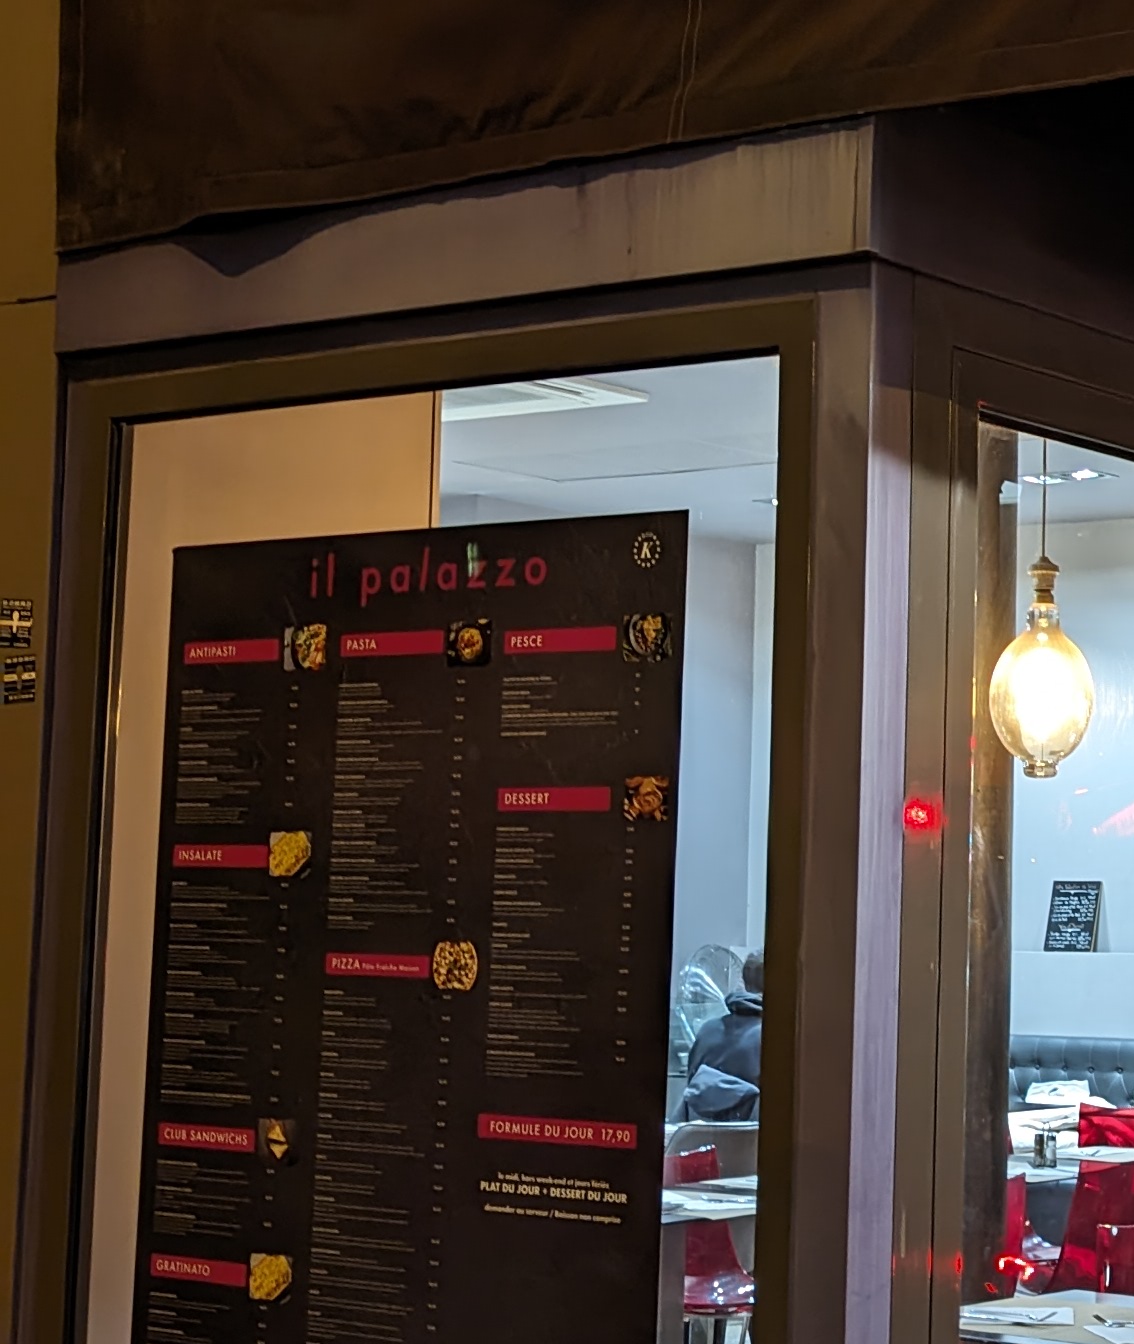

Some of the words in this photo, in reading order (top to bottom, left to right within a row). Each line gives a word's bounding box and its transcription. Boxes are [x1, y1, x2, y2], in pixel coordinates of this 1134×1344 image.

[310, 552, 336, 599] il
[360, 545, 548, 608] palazzo
[346, 638, 377, 651] PASTA
[510, 634, 543, 648] PESCE
[189, 646, 236, 659] ANTIPASTI
[504, 792, 550, 805] DESSERT
[178, 849, 222, 861] INSALATE
[332, 957, 360, 969] PIZZA
[163, 1127, 187, 1141] CLUB
[190, 1129, 248, 1145] SANDWICHS
[490, 1120, 541, 1136] FORMULE
[544, 1125, 560, 1137] DU
[564, 1126, 594, 1140] JOUR
[601, 1128, 630, 1143] 17,90
[480, 1180, 501, 1192] PLAT
[502, 1182, 515, 1194] DU
[517, 1184, 540, 1196] JOUR
[550, 1186, 586, 1200] DESSERT
[587, 1190, 601, 1202] DU
[602, 1191, 628, 1204] JOUR
[156, 1259, 210, 1276] GRATINATO
